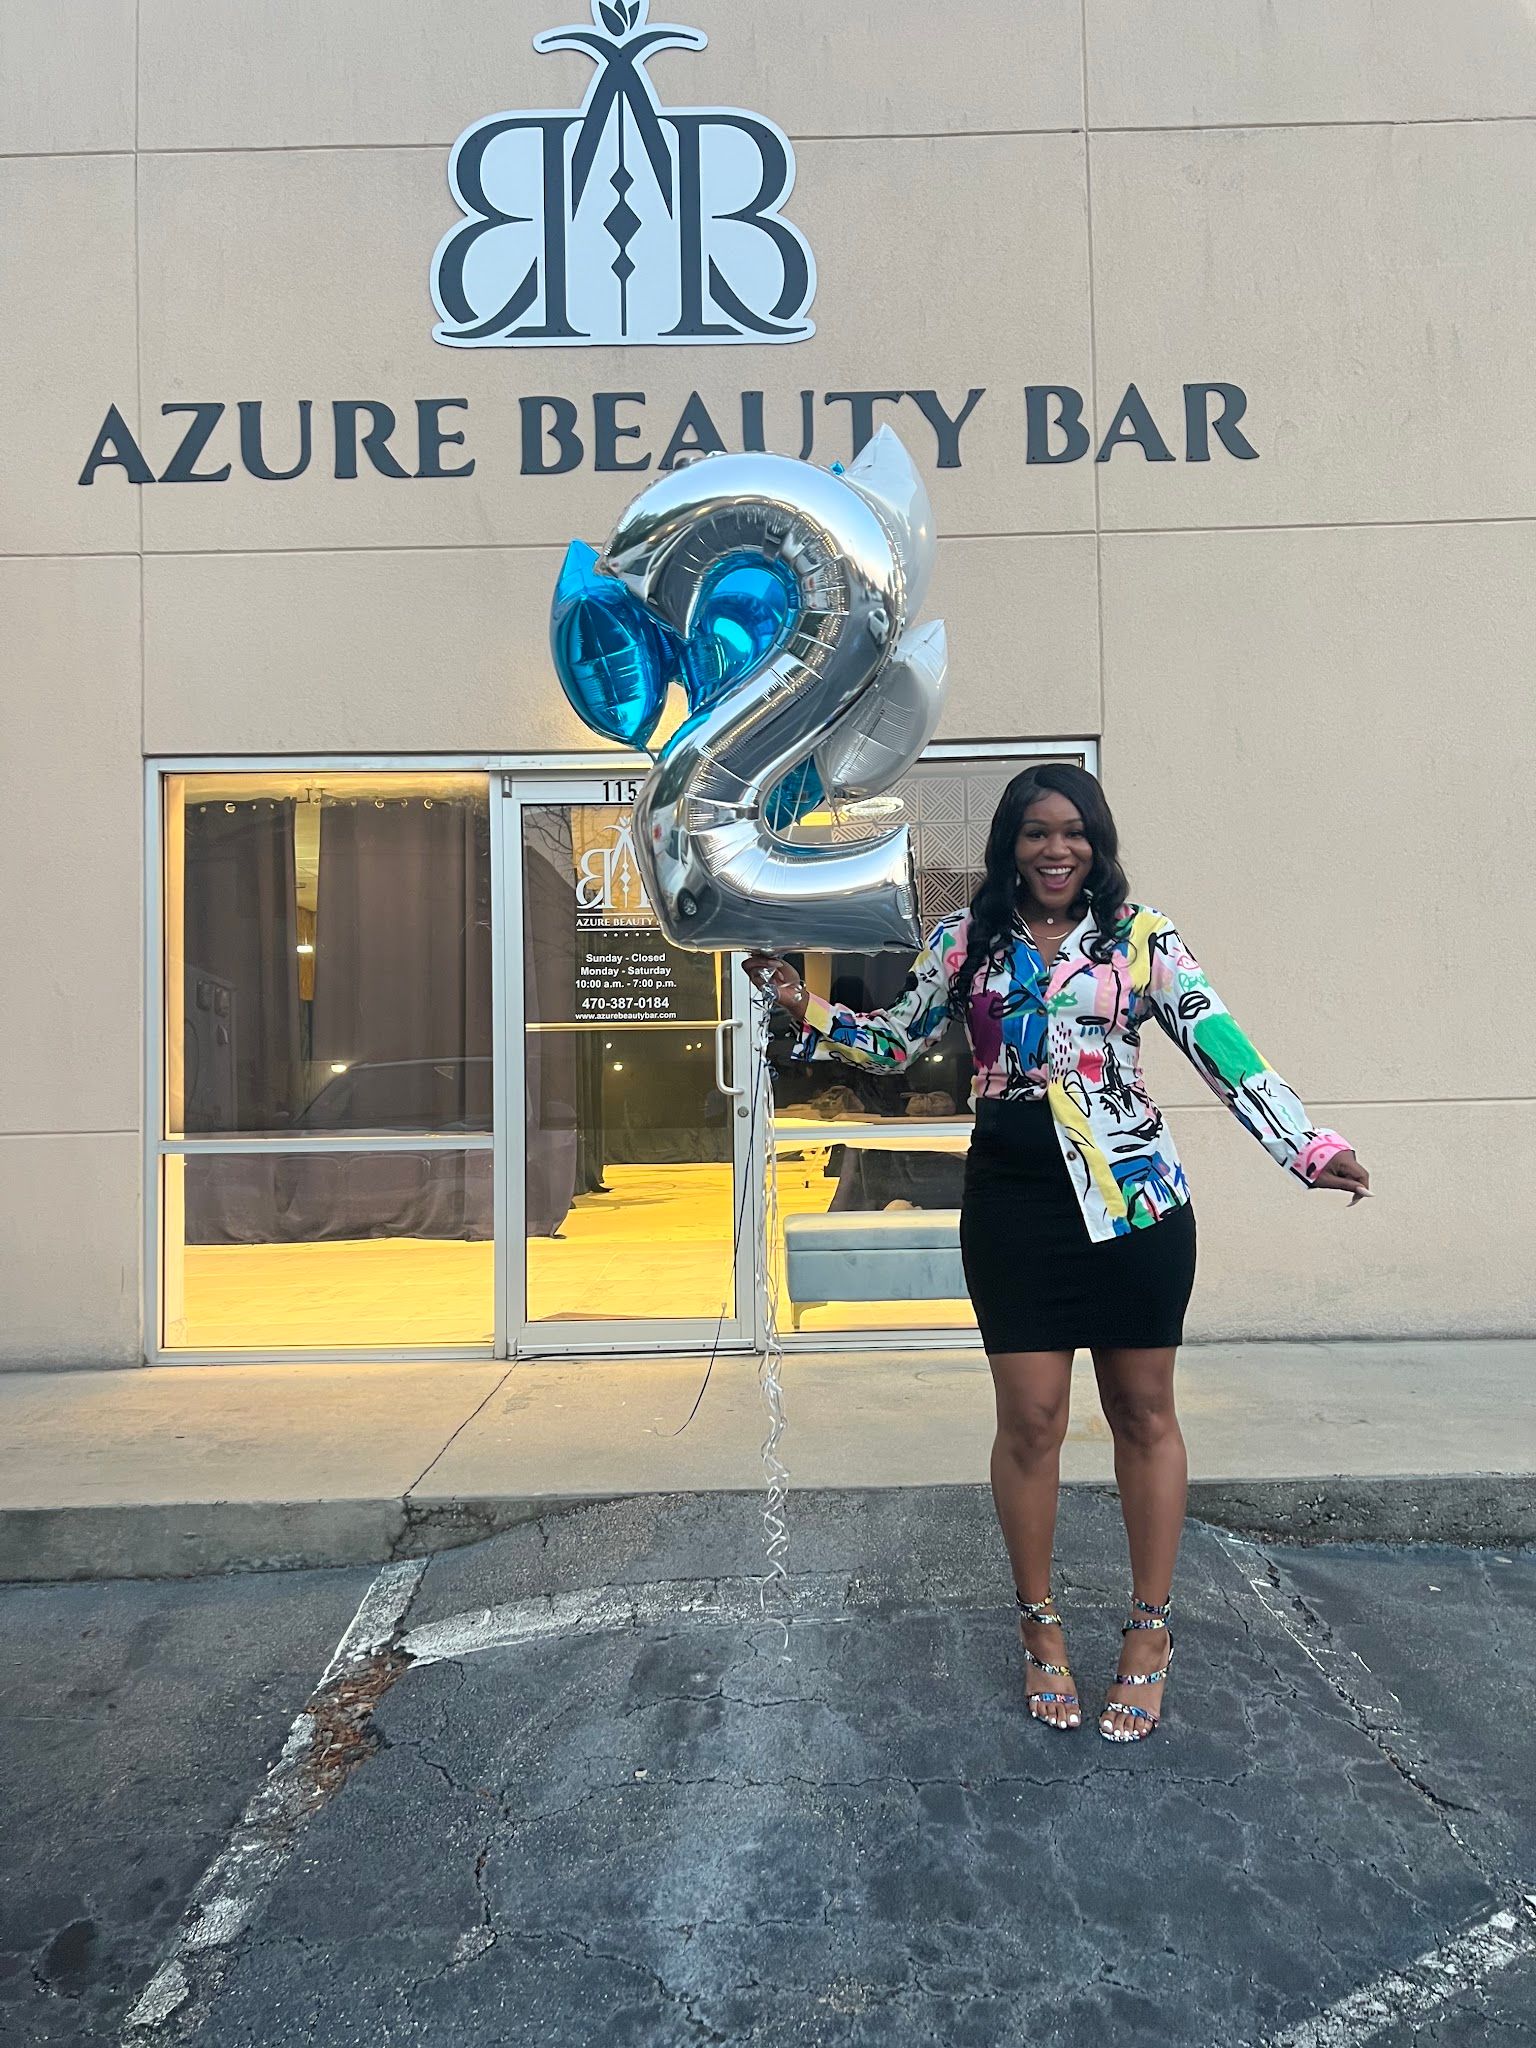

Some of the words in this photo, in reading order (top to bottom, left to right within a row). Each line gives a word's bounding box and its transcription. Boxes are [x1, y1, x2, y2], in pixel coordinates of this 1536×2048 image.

[78, 398, 477, 486] AZURE
[520, 387, 987, 475] BEAUTY
[1025, 382, 1260, 465] BAR
[603, 780, 637, 801] 115
[576, 918, 611, 927] AZURE
[613, 917, 654, 926] BEAUTY
[585, 953, 623, 964] Sunday
[631, 953, 666, 962] Closed
[580, 966, 619, 977] Monday
[627, 966, 671, 976] Saturday
[575, 979, 601, 988] 10:00
[603, 980, 625, 988] a.m.
[632, 979, 654, 987] 7:00
[655, 979, 677, 989] p.m.
[581, 997, 670, 1009] 470-387-0184
[575, 1012, 677, 1020] www.azurebeautybar.com
